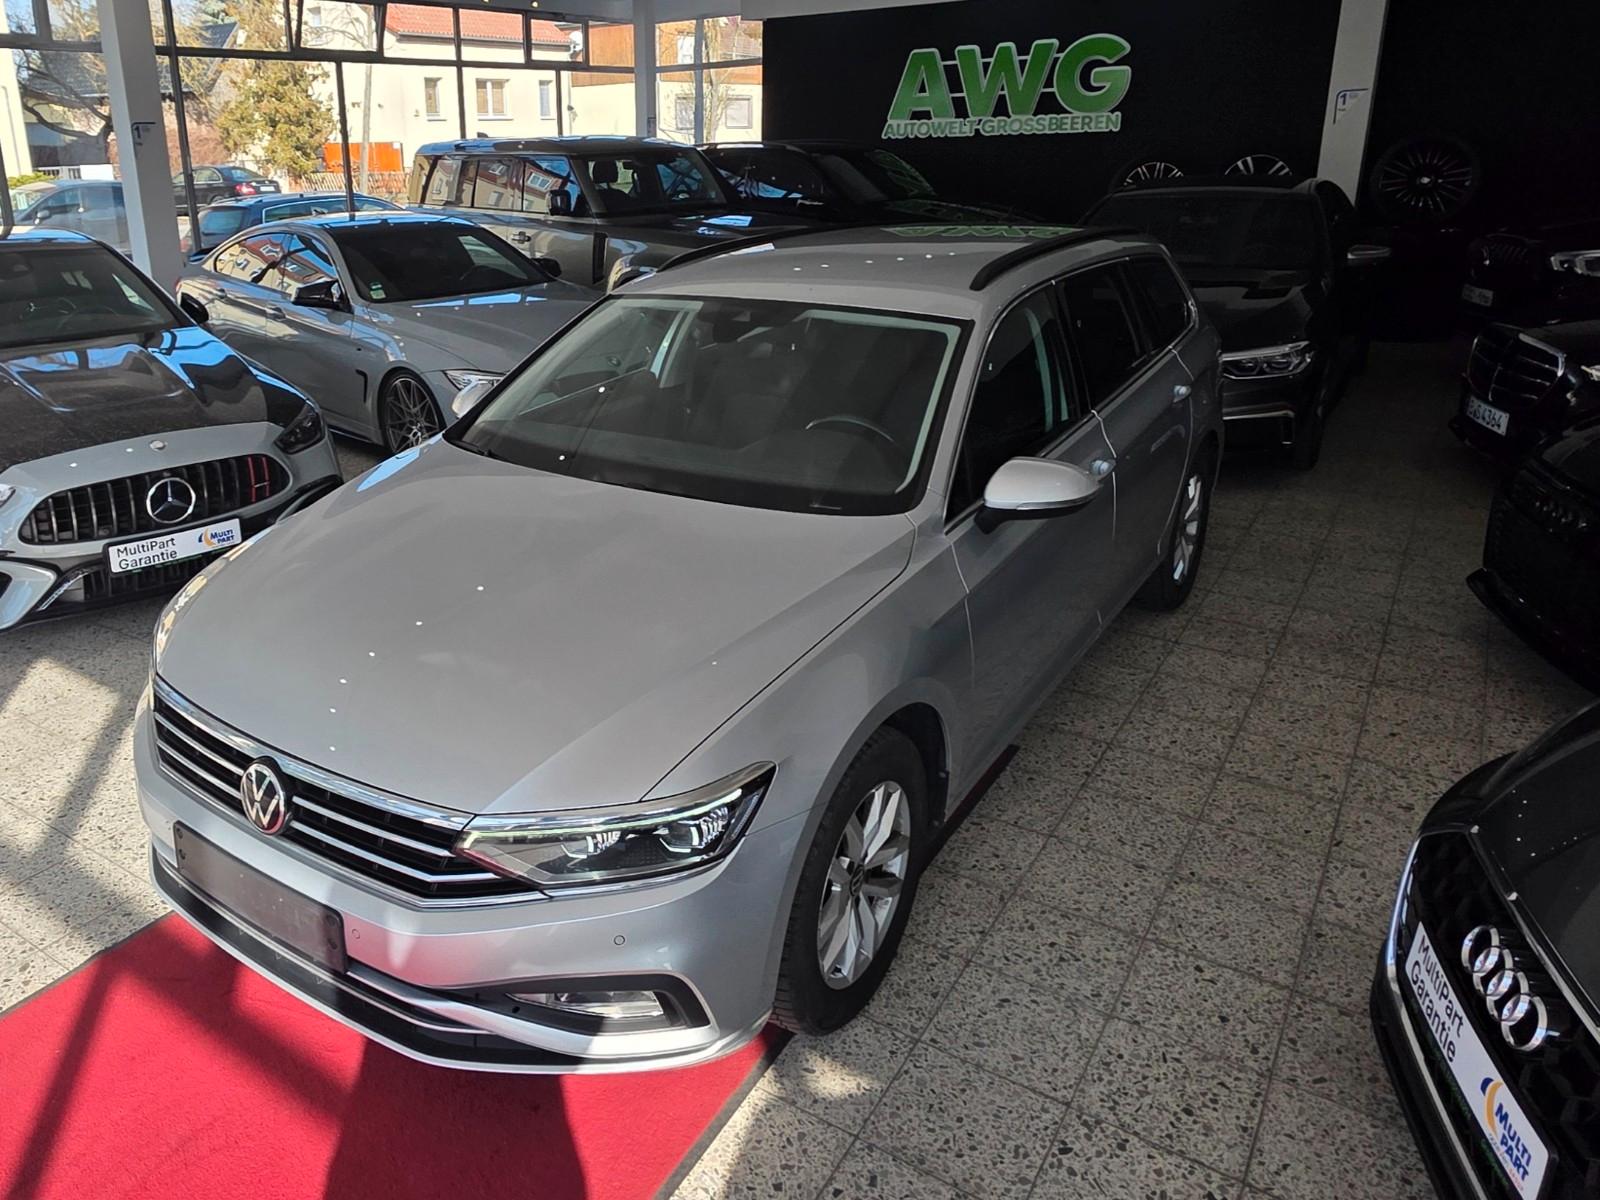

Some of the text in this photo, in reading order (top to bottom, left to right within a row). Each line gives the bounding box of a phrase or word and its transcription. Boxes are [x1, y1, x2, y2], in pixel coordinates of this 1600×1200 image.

[887, 33, 1131, 121] AWG
[882, 112, 1121, 139] AUTOWELT GROSSBEEREN
[117, 537, 176, 558] MultiPart
[118, 549, 178, 570] Garantie
[1410, 960, 1456, 1062] Garantie
[1417, 935, 1464, 1038] MultiPart
[1495, 1102, 1532, 1167] MULTI
[1500, 1133, 1529, 1181] PART
